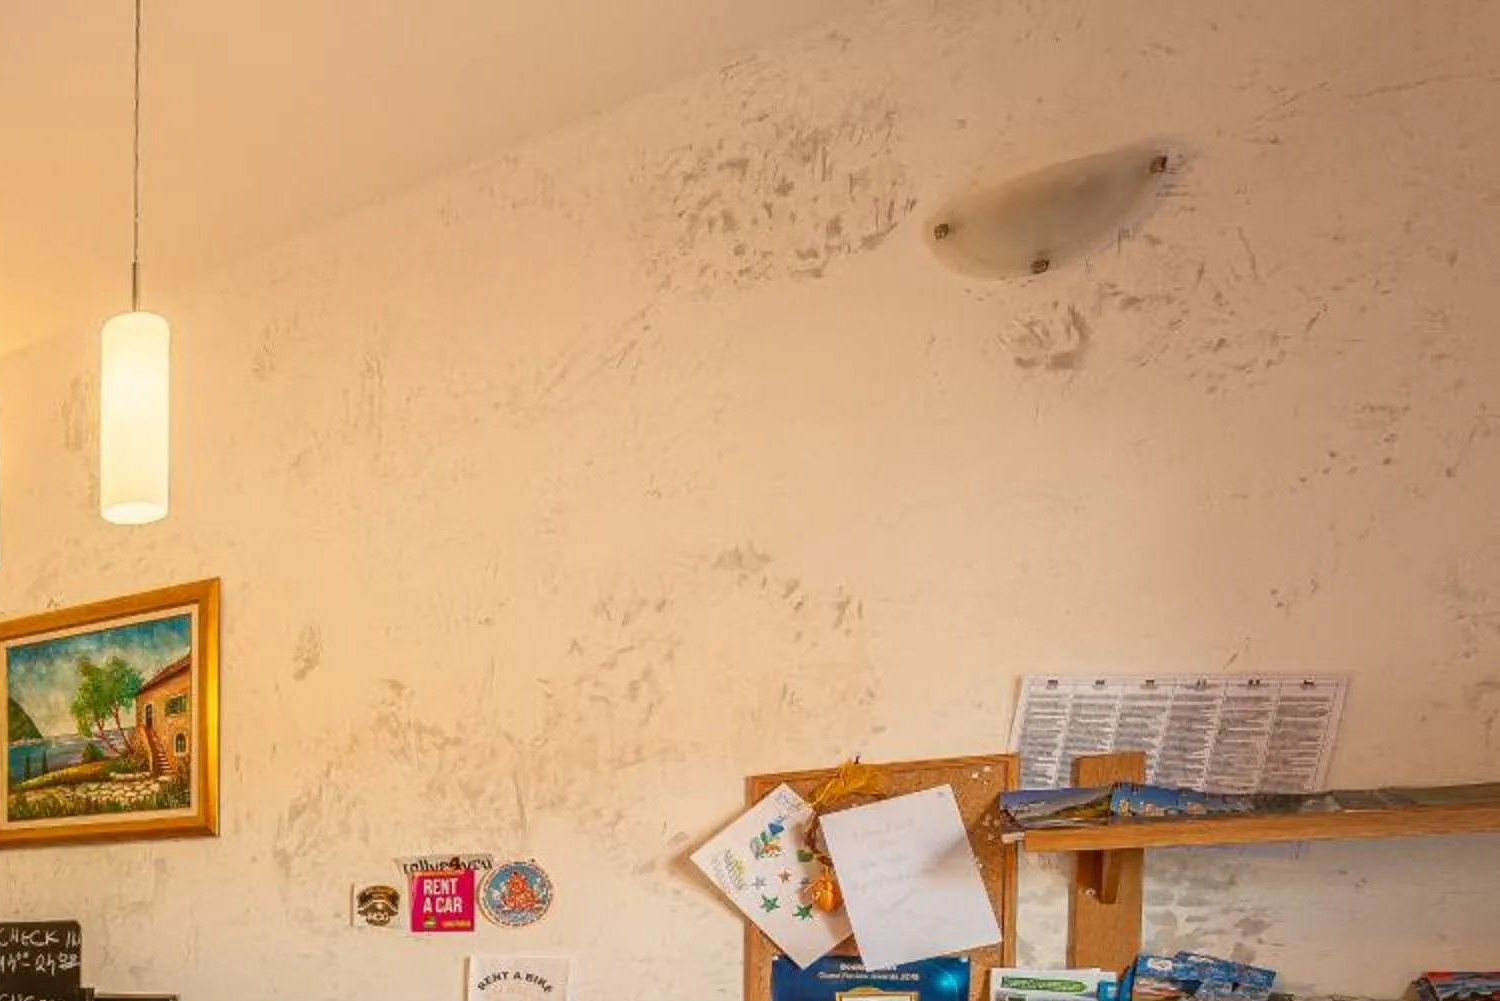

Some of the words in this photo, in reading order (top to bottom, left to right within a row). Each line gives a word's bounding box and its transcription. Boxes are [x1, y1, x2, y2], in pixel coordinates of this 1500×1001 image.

[423, 877, 459, 895] RENT
[423, 897, 433, 913] A
[435, 897, 463, 913] CAR
[477, 971, 508, 991] RENT
[513, 971, 523, 981] A
